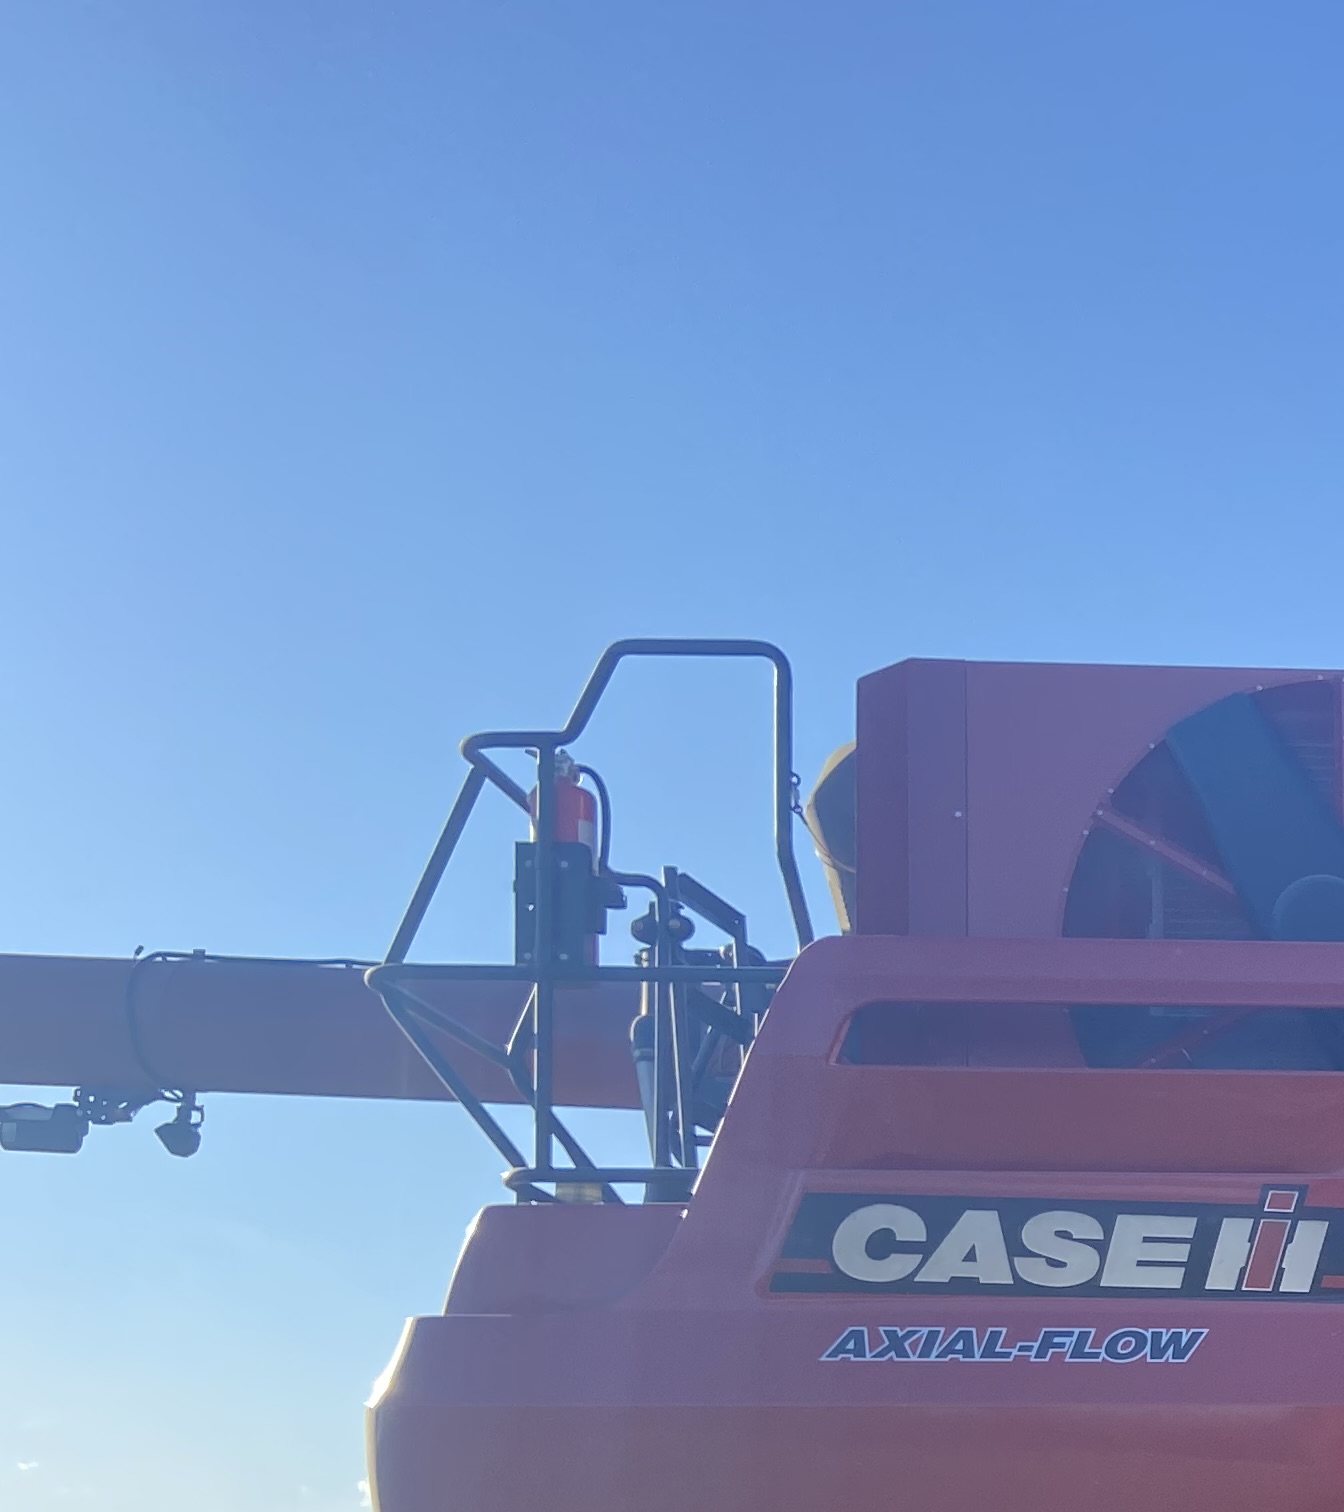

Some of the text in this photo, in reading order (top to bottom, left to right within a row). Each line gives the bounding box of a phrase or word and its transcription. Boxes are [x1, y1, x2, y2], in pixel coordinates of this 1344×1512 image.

[832, 1189, 1330, 1293] CASE IH
[818, 1326, 1210, 1364] AXIAL-FLOW
